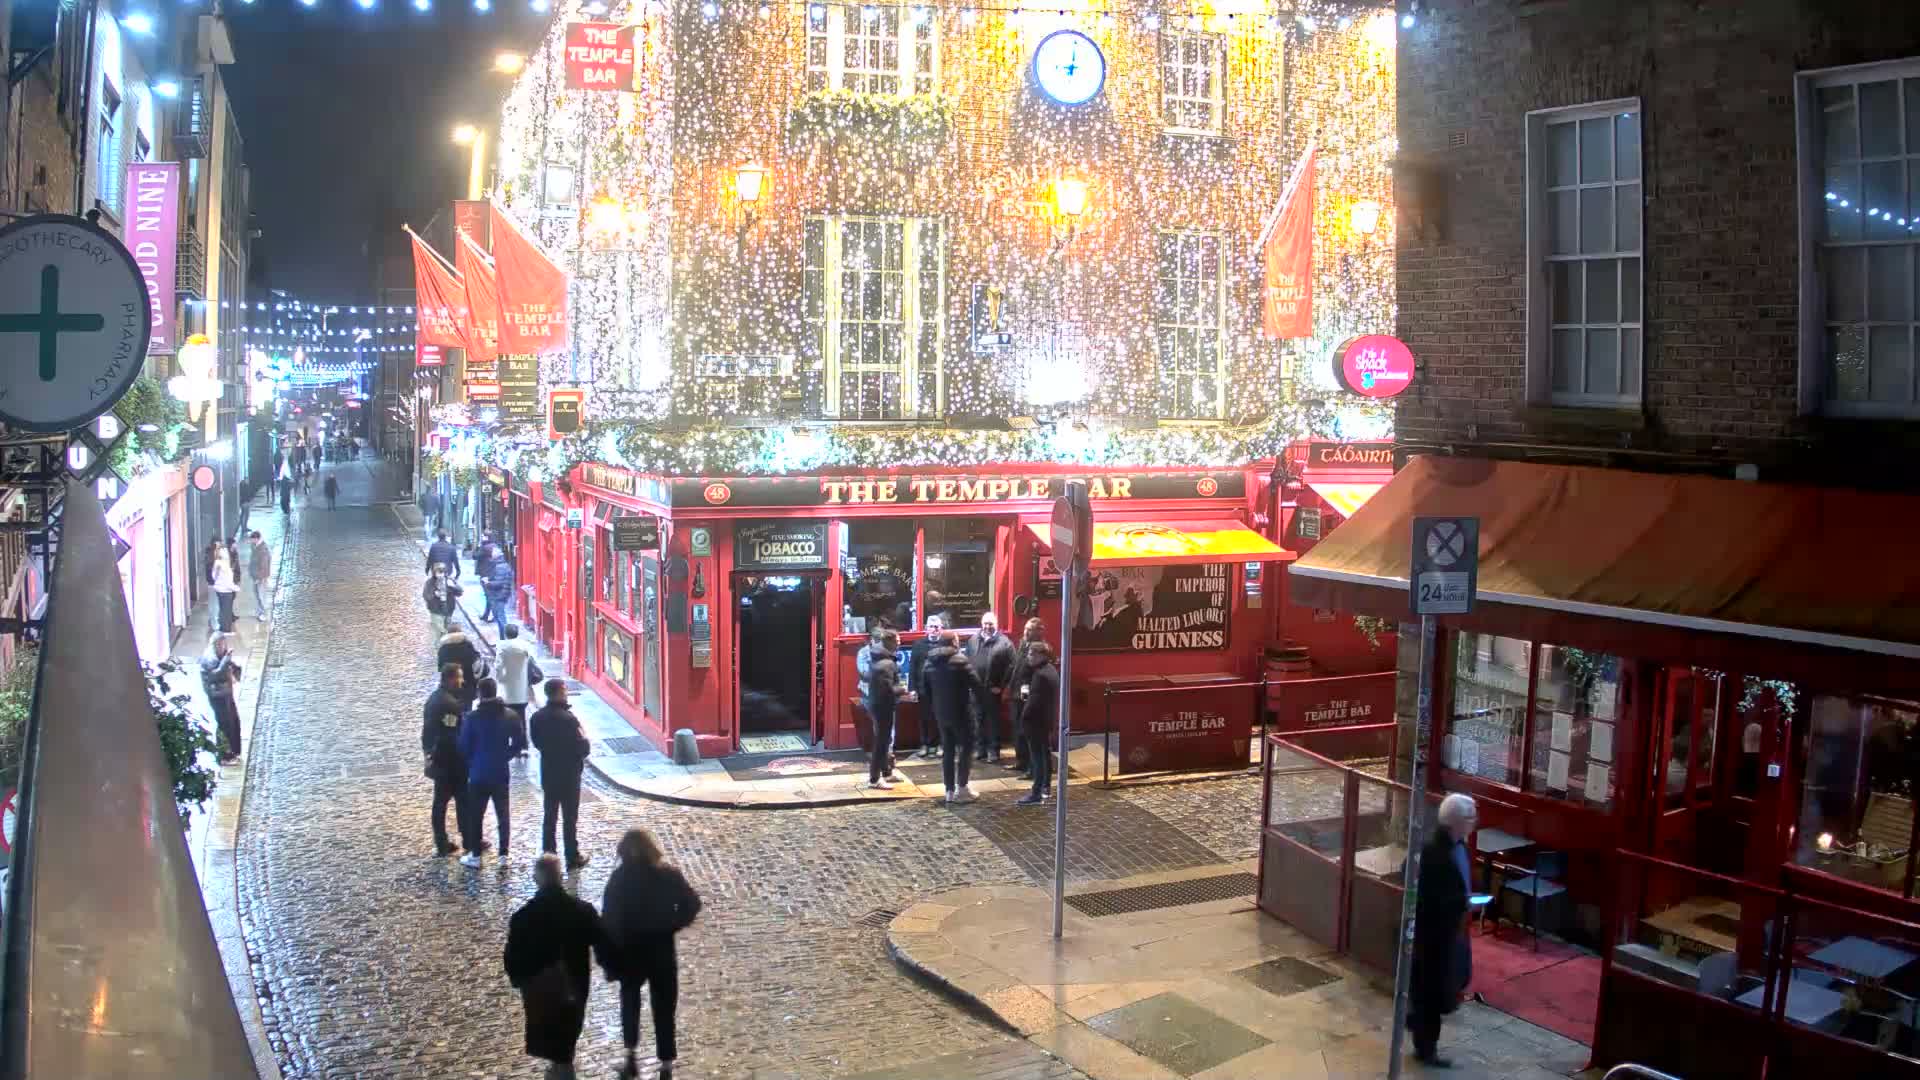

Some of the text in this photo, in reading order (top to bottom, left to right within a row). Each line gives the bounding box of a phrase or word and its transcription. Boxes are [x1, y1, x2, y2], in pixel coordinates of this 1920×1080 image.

[584, 28, 617, 45] THE
[568, 47, 632, 64] TEMPLE
[584, 68, 616, 83] BAR
[136, 169, 169, 232] NINE
[522, 304, 546, 313] THE
[504, 312, 565, 324] TEMPLE
[519, 325, 551, 337] BAR
[90, 303, 137, 400] PHARMACY
[709, 487, 725, 500] 48
[823, 477, 1132, 504] THE TEMPLE AR
[1199, 481, 1213, 494] 48
[751, 539, 816, 561] TOBACCO
[1203, 563, 1225, 577] THE
[1175, 578, 1226, 593] EMPEROR
[1421, 583, 1442, 601] 24
[1211, 592, 1225, 607] OF
[1136, 607, 1226, 632] MALTED LIQUORS
[1131, 630, 1224, 650] GUINNESS
[1330, 700, 1349, 709] THE
[1178, 711, 1198, 720] THE
[1304, 704, 1372, 721] TEMPLE BAR
[1148, 717, 1225, 733] TEMPLE BAR
